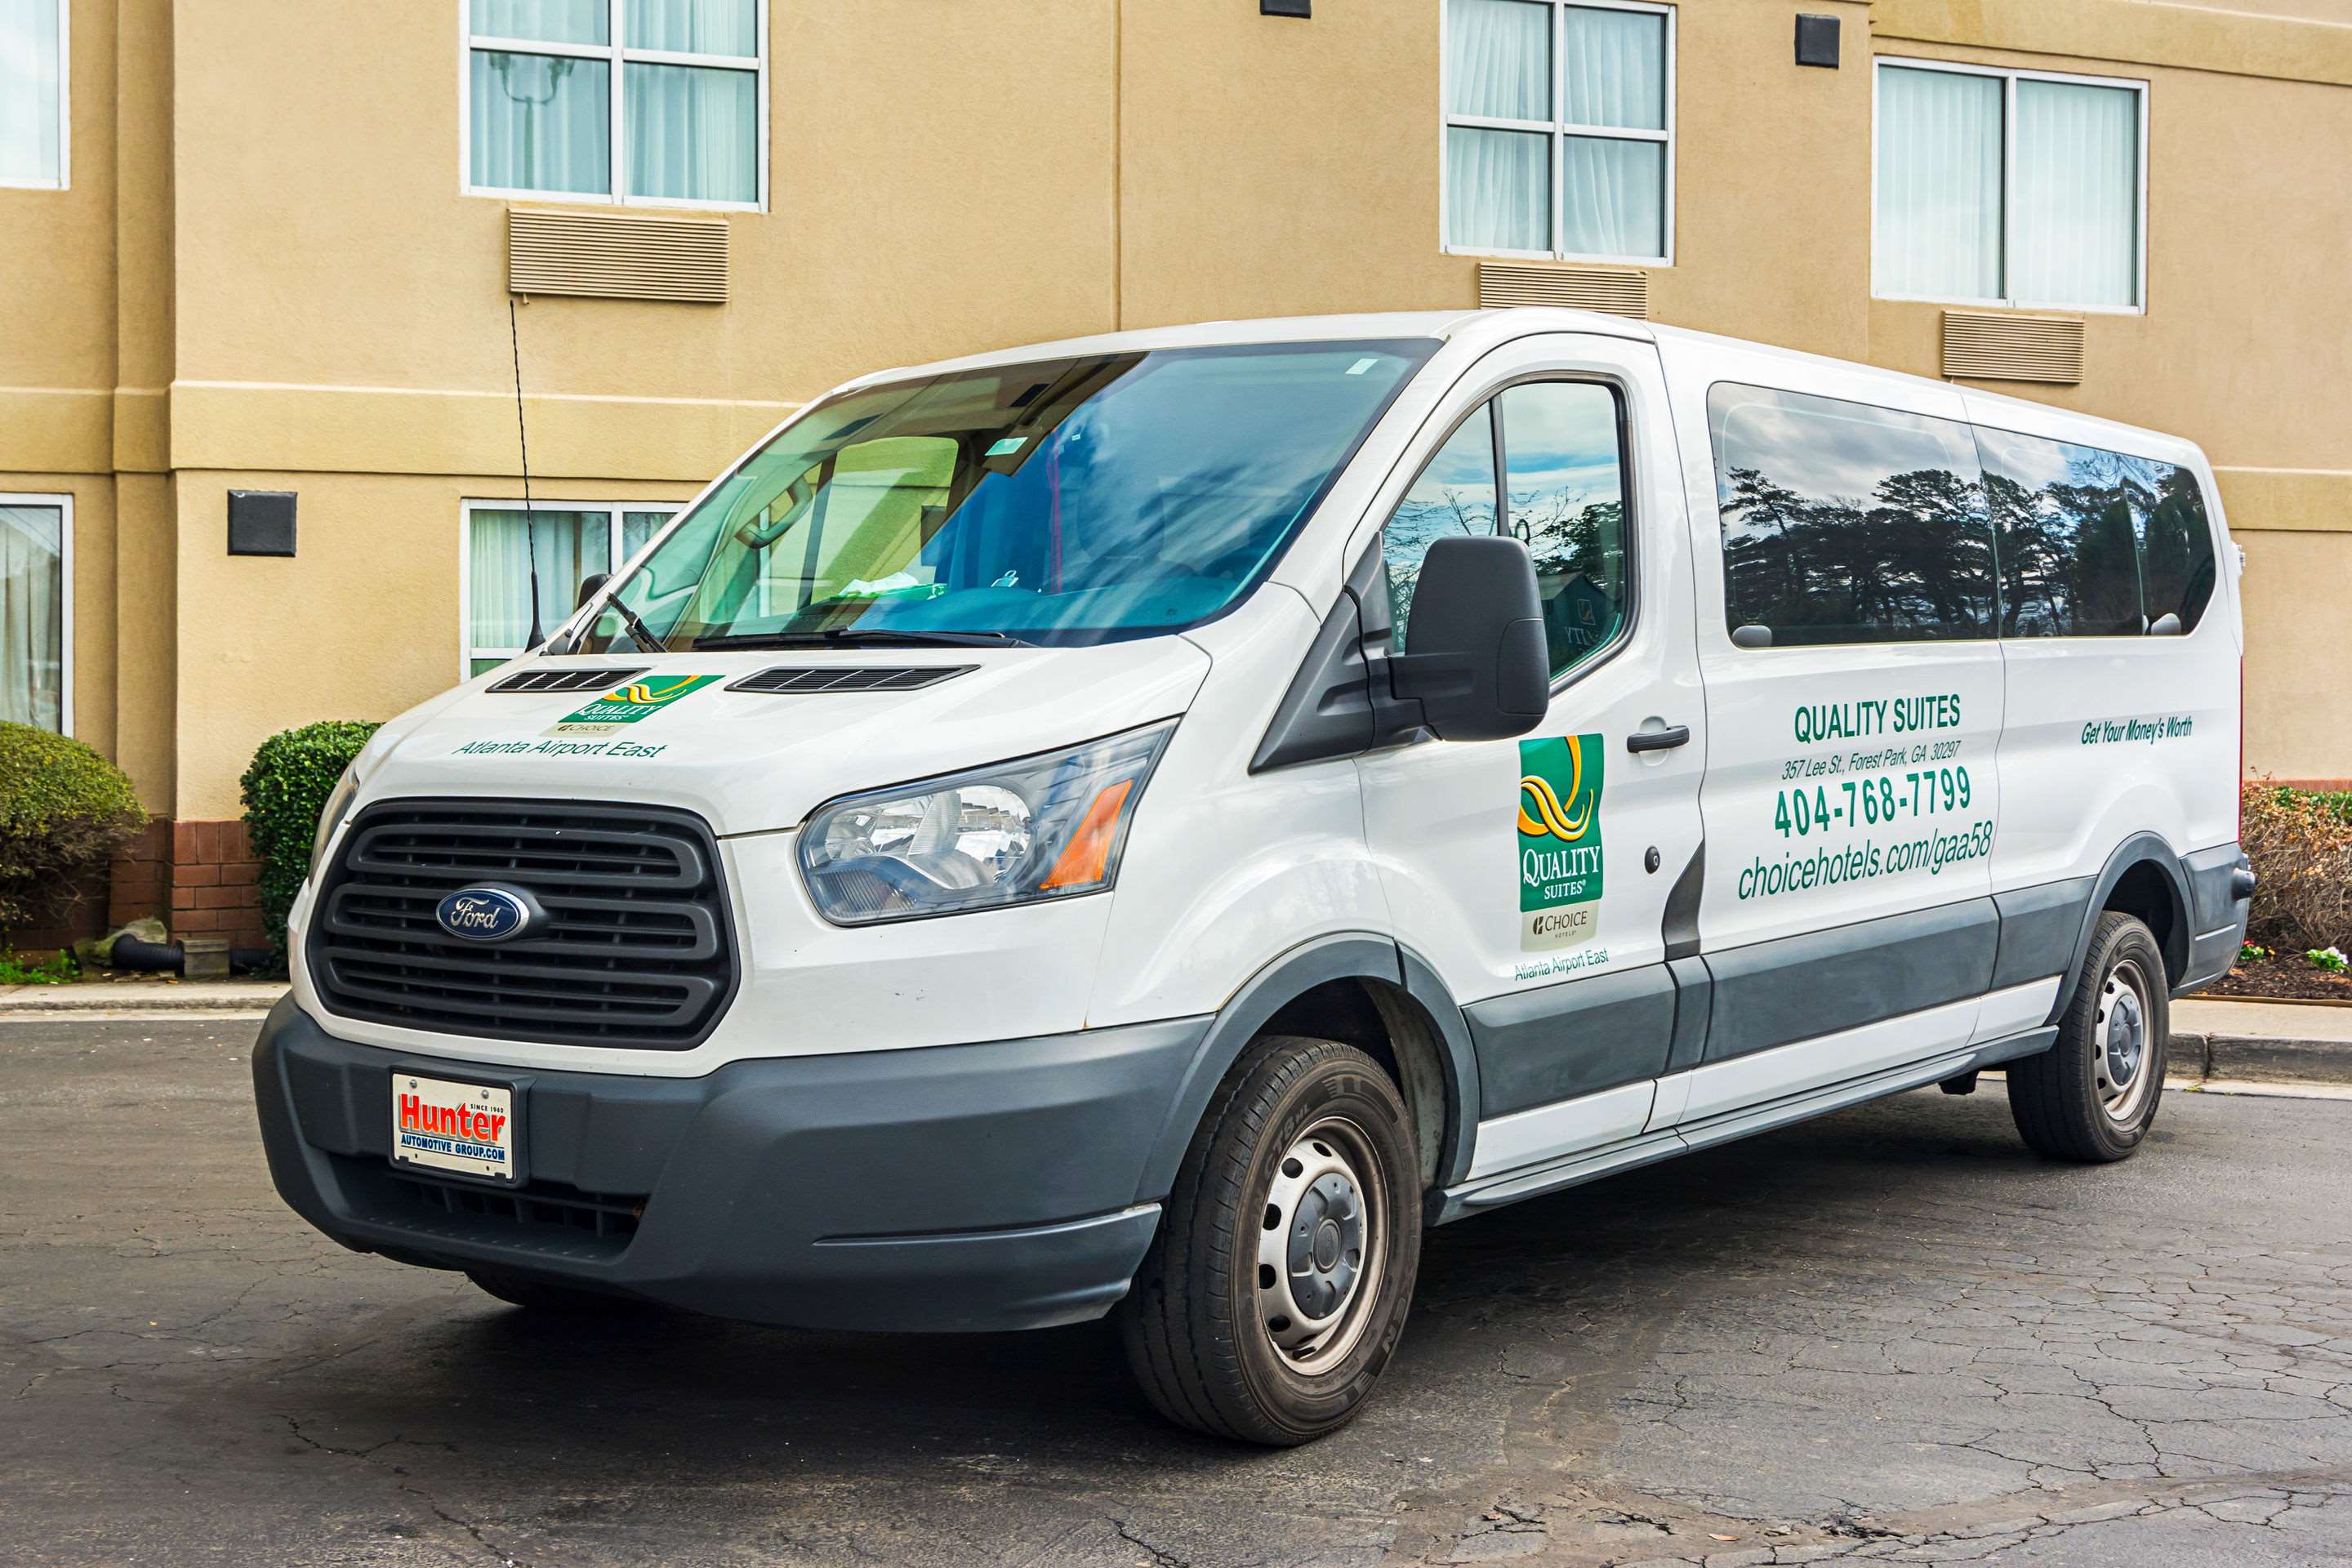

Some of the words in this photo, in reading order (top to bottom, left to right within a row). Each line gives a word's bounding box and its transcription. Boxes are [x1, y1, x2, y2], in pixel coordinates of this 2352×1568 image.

[576, 704, 662, 715] QUALITY
[1795, 700, 1887, 744] QUALITY
[1893, 694, 1961, 733] SUITES
[2082, 721, 2102, 745] Get
[2102, 721, 2125, 743] Your
[2126, 718, 2164, 745] Money's
[2166, 715, 2193, 738] Worth
[452, 741, 529, 755] Atlanta
[528, 741, 609, 758] Airport
[607, 742, 667, 758] East
[1782, 760, 1805, 780] 357
[1806, 756, 1826, 777] Lee
[1829, 755, 1845, 775] St.,
[1849, 750, 1882, 772] Forest
[1882, 747, 1907, 768] Park,
[1911, 744, 1927, 764] GA
[1931, 740, 1962, 760] 30297
[1775, 765, 1971, 838] 404-768-7799
[1523, 846, 1600, 887] QUALITY
[1739, 820, 1993, 900] choicehotels.com/gaa58
[1544, 880, 1582, 899] SUITES
[451, 897, 501, 929] Ford
[1545, 911, 1588, 931] CHOICE
[1515, 964, 1551, 981] Atlanta
[1552, 954, 1585, 973] Airport
[1586, 948, 1610, 965] East
[400, 1094, 506, 1142] Hunter
[470, 1103, 488, 1111] SINCE
[401, 1134, 452, 1152] AUTOMOTIVE
[455, 1143, 506, 1161] GROUP.COM
